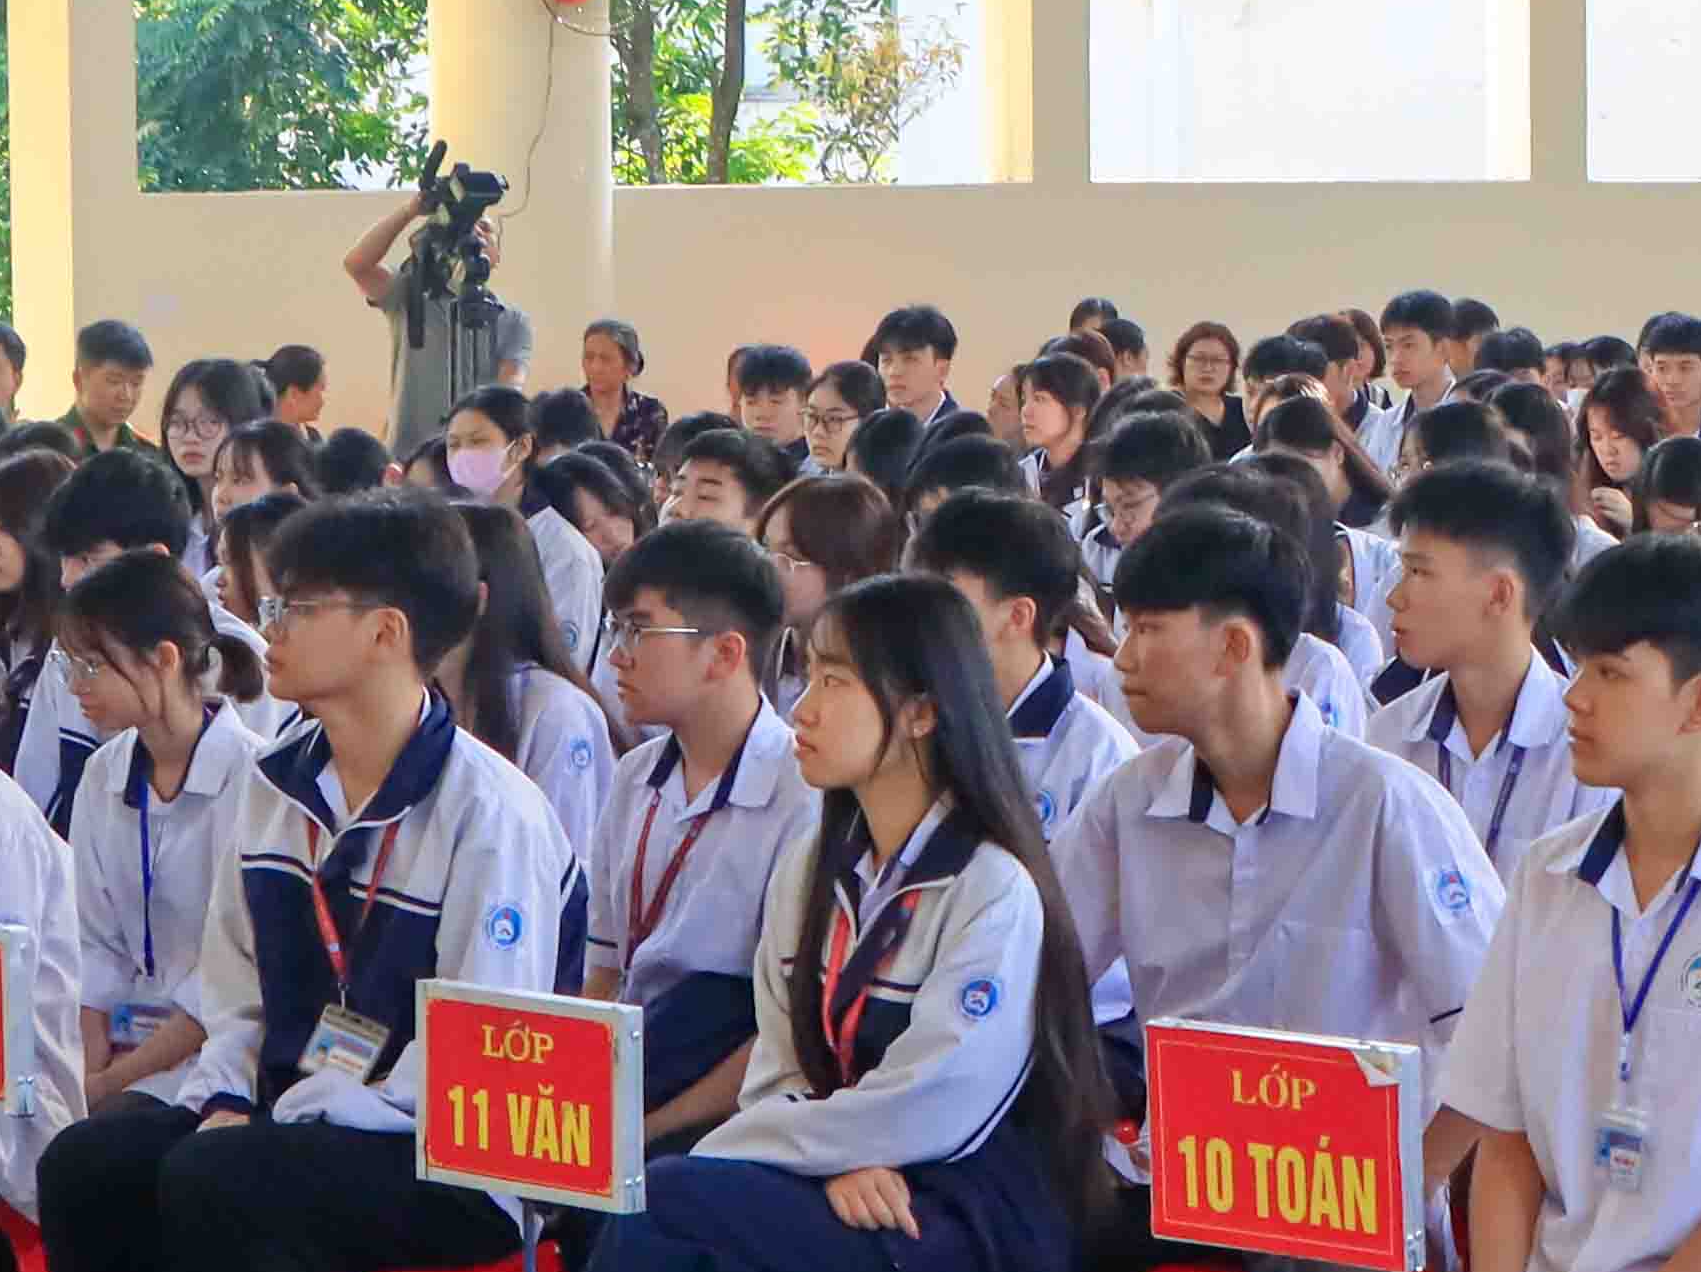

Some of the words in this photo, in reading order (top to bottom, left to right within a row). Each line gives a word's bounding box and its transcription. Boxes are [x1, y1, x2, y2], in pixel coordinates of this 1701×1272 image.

[482, 1020, 555, 1064] LỚP
[1232, 1063, 1316, 1111] LỚP
[448, 1085, 488, 1151] 11
[506, 1083, 591, 1168] VĂN
[1178, 1135, 1234, 1213] 10
[1247, 1134, 1378, 1235] TOÁN
